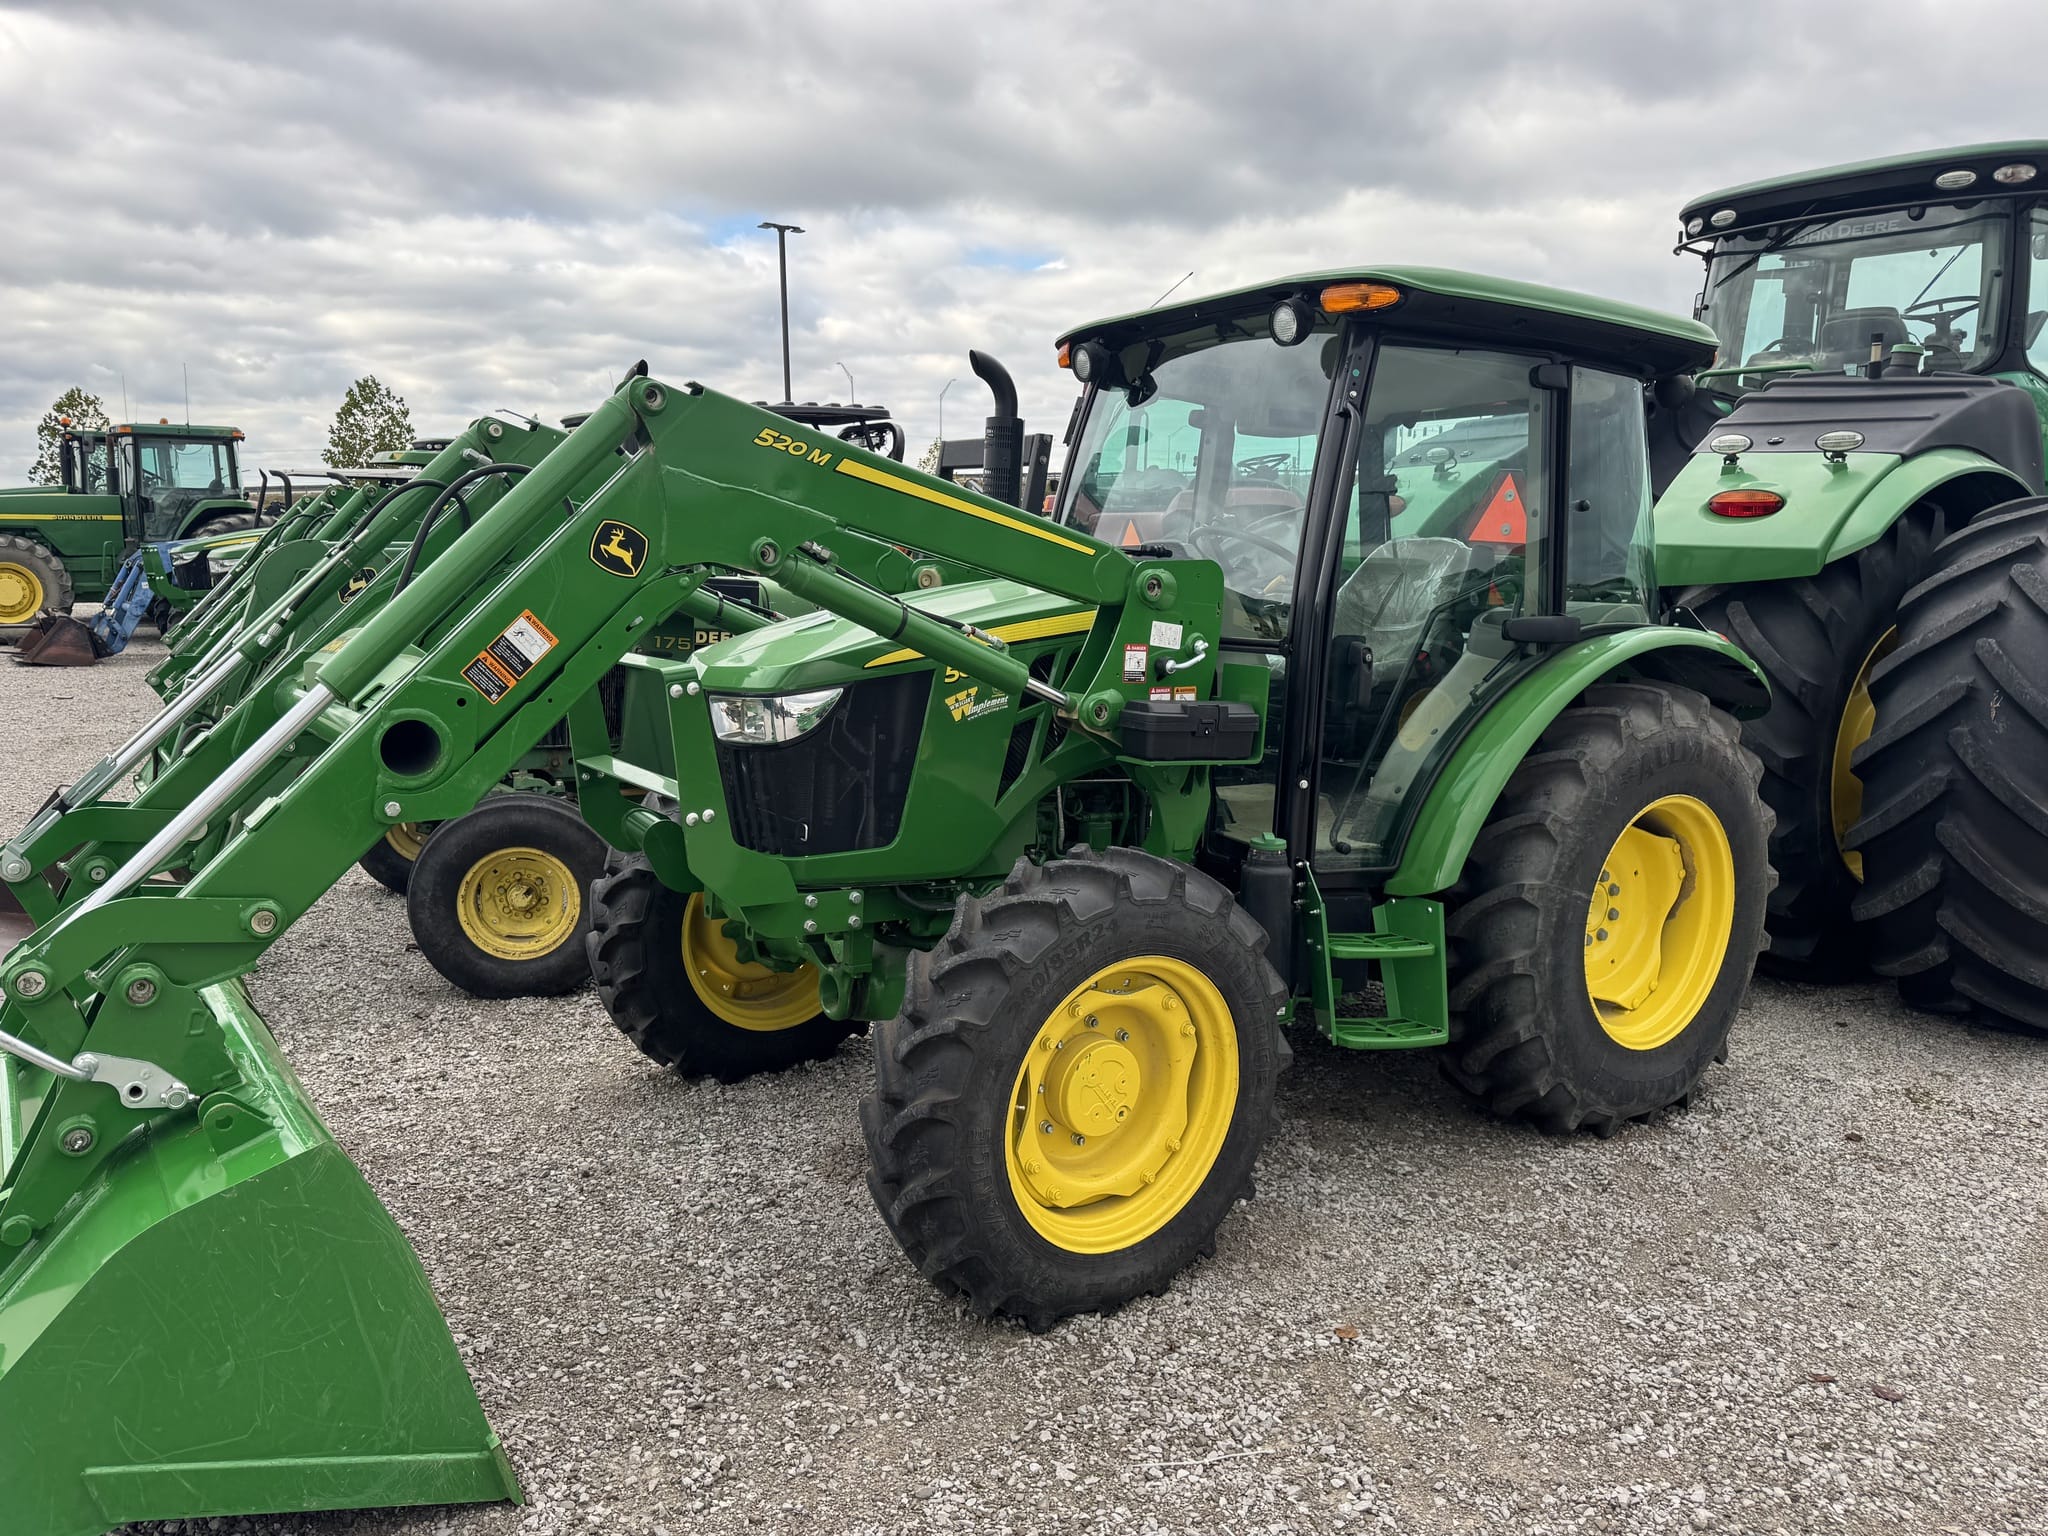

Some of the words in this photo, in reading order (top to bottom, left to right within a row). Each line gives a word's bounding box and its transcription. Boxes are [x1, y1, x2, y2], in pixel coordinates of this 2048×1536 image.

[1838, 220, 1900, 239] DEERE
[753, 427, 808, 456] 520
[806, 447, 833, 466] M
[531, 619, 554, 642] WARNING
[488, 661, 511, 684] WARNING
[944, 665, 970, 684] 5
[968, 695, 1009, 715] Implement
